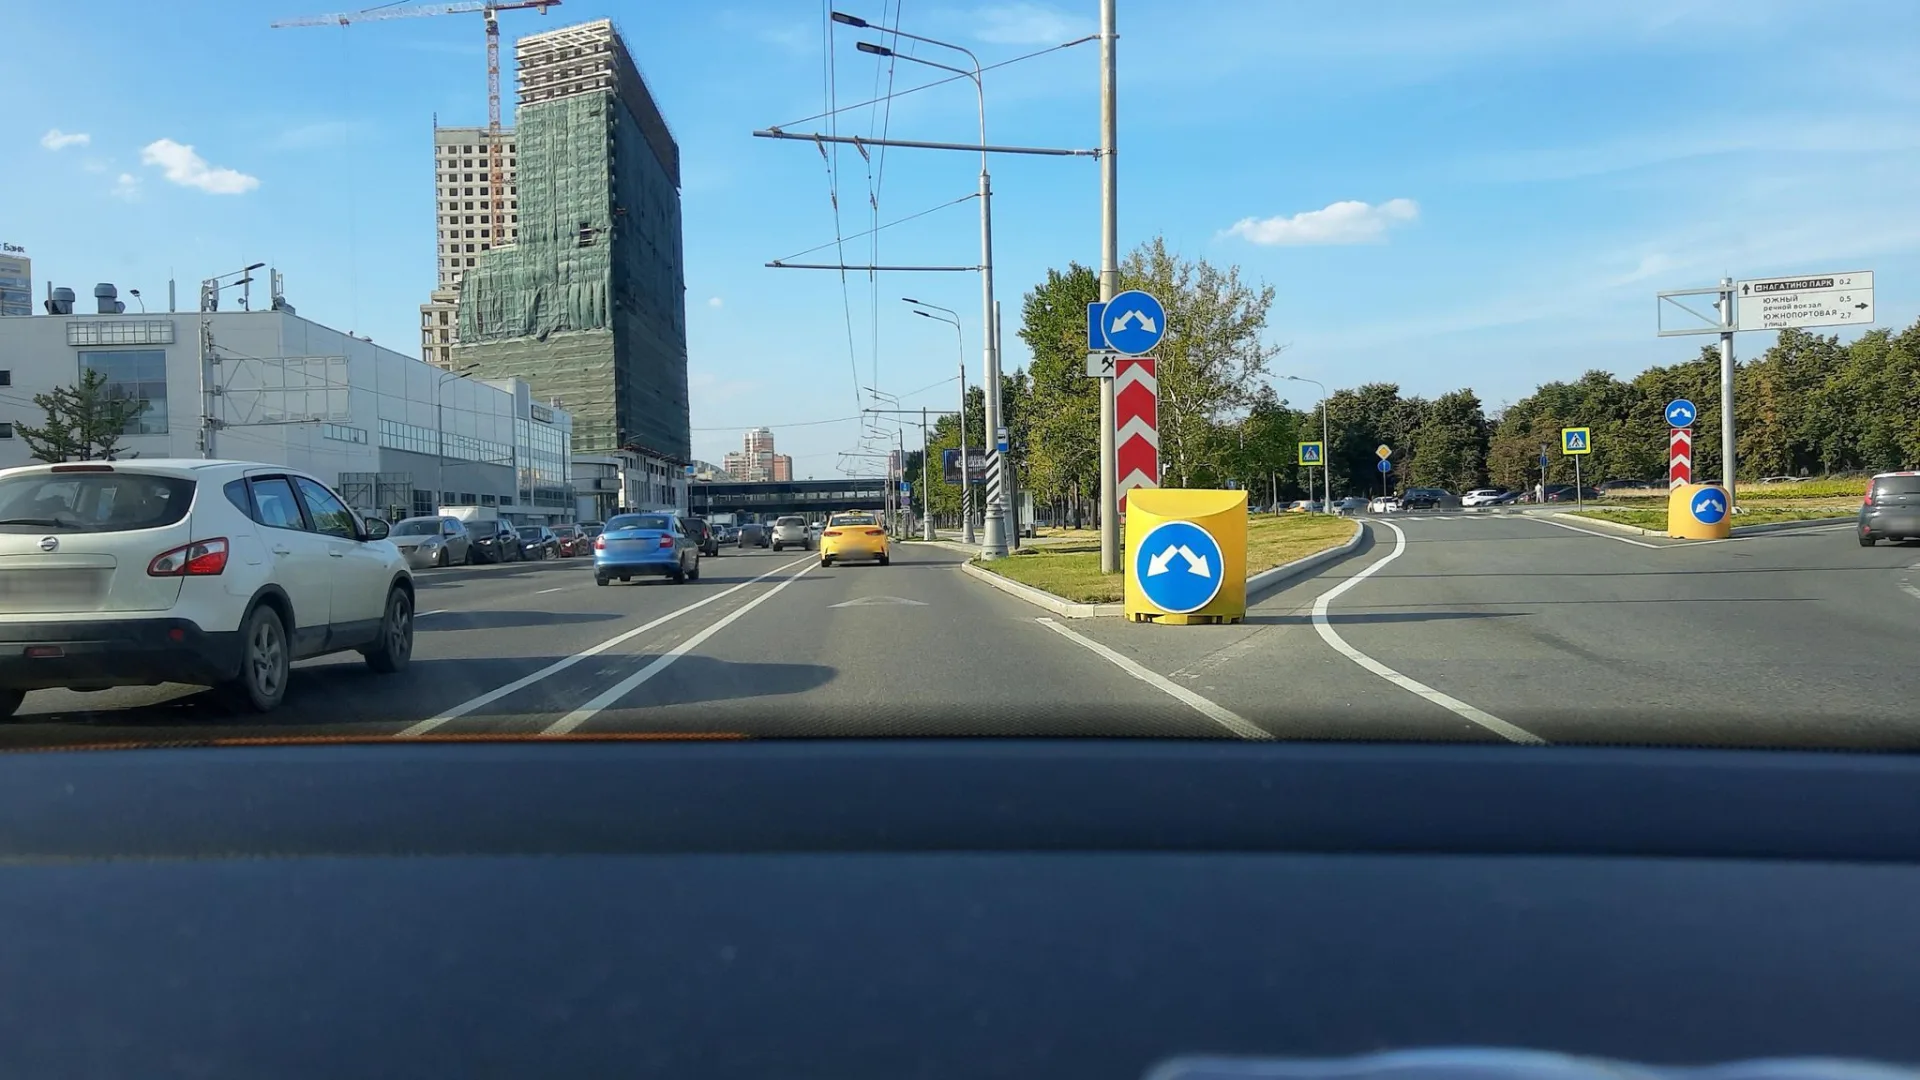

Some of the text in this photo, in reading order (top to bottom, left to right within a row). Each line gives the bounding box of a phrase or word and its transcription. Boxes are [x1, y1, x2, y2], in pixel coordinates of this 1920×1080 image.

[3, 242, 25, 253] Банк
[1762, 279, 1833, 291] НАГАТИНО ПАРК
[1763, 295, 1798, 304] ЮЖНЫЙ
[1763, 304, 1792, 312] речной
[1763, 310, 1838, 320] ЮЖНОПОРТОВАЯ
